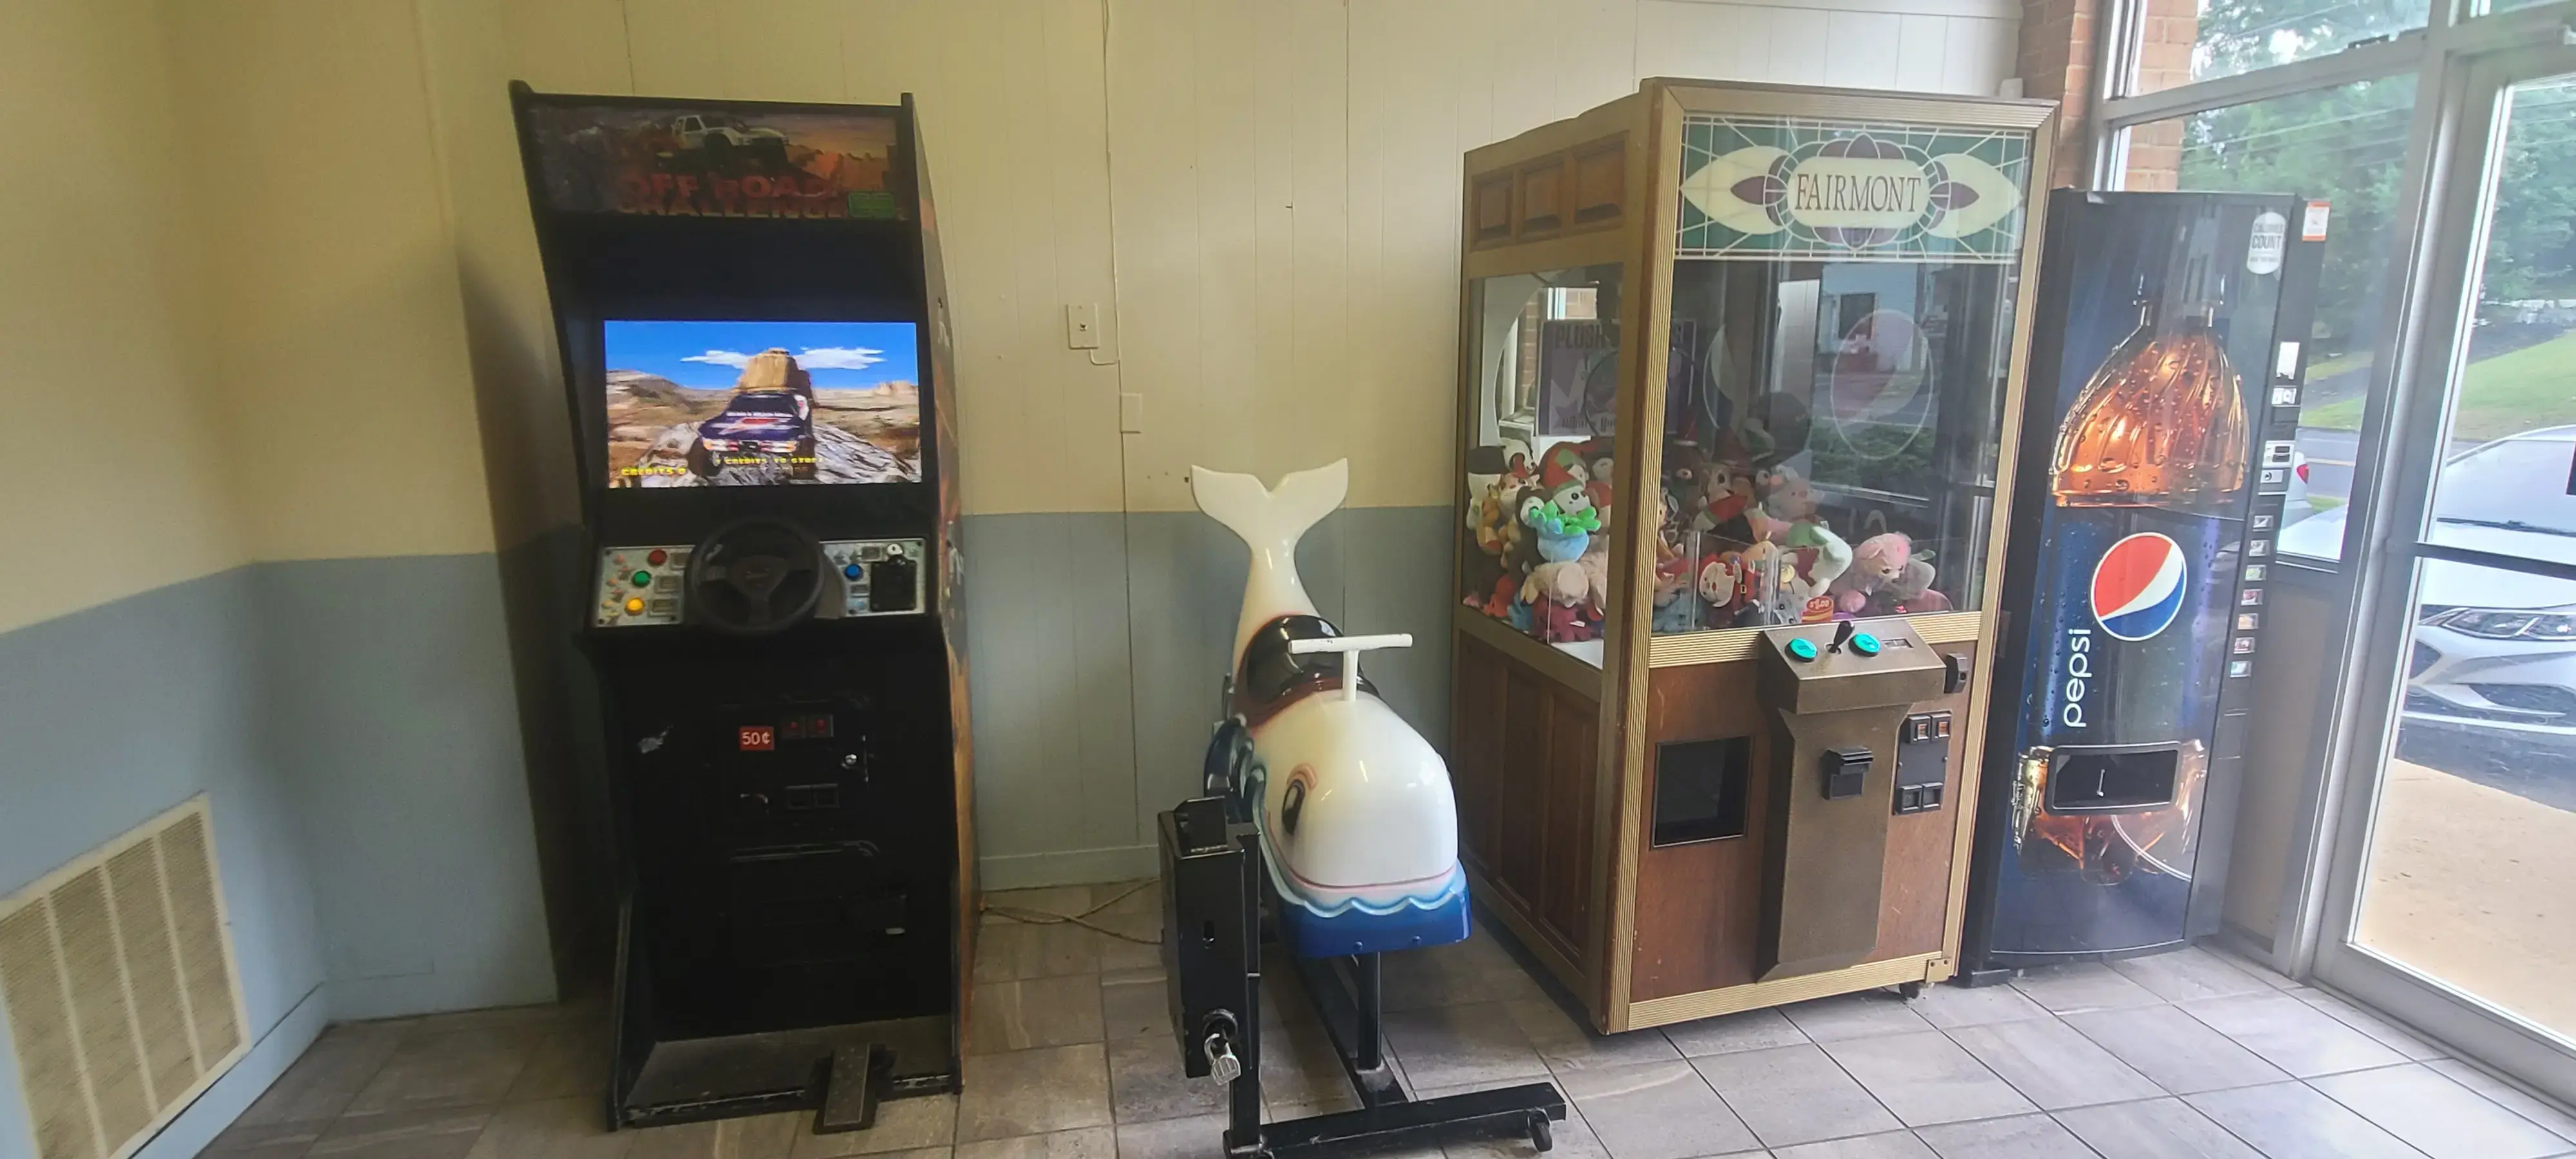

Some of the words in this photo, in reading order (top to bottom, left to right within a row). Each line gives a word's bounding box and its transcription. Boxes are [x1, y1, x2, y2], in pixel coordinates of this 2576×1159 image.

[1795, 174, 1920, 212] FAIRMONT
[2252, 235, 2282, 249] COUNT
[2064, 628, 2092, 728] pepsi
[742, 731, 770, 745] 50¢
